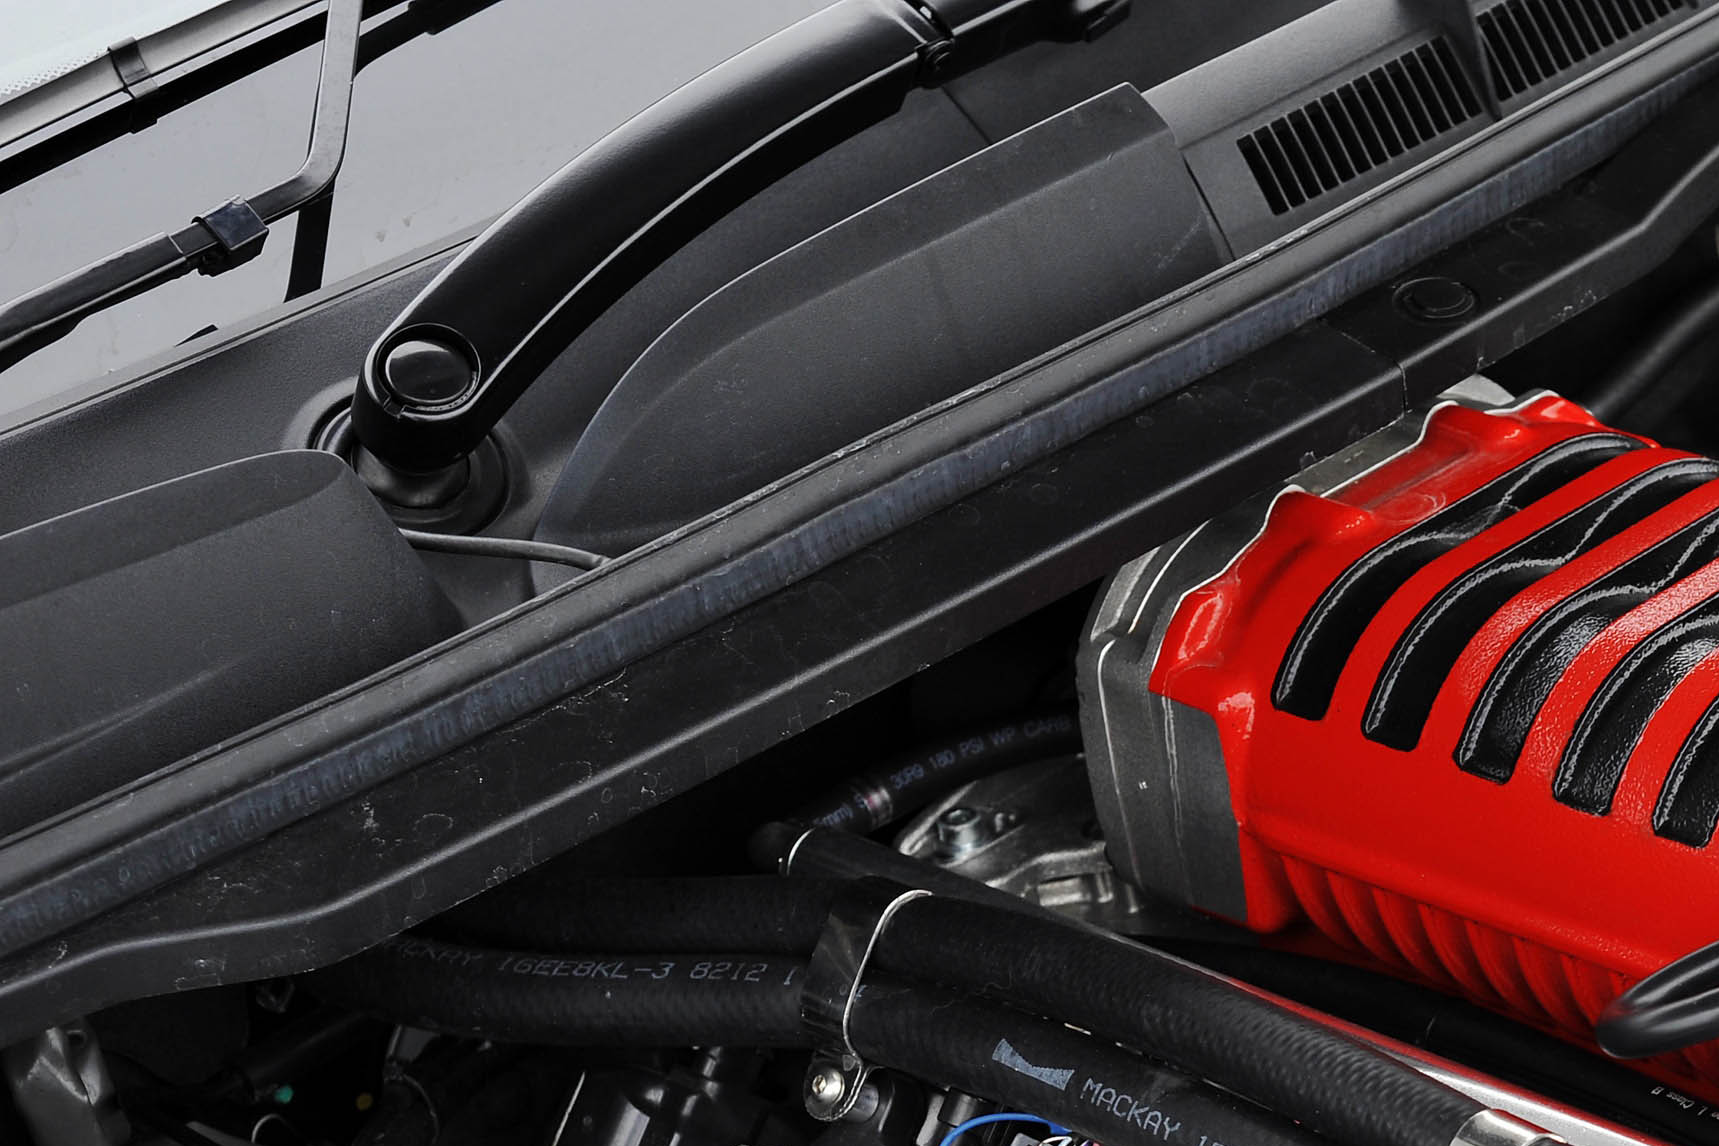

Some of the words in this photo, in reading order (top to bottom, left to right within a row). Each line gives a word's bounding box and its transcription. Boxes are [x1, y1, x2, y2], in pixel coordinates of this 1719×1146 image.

[959, 739, 985, 758] PSI
[689, 961, 769, 983] 8212
[1079, 1078, 1182, 1141] MACKAY
